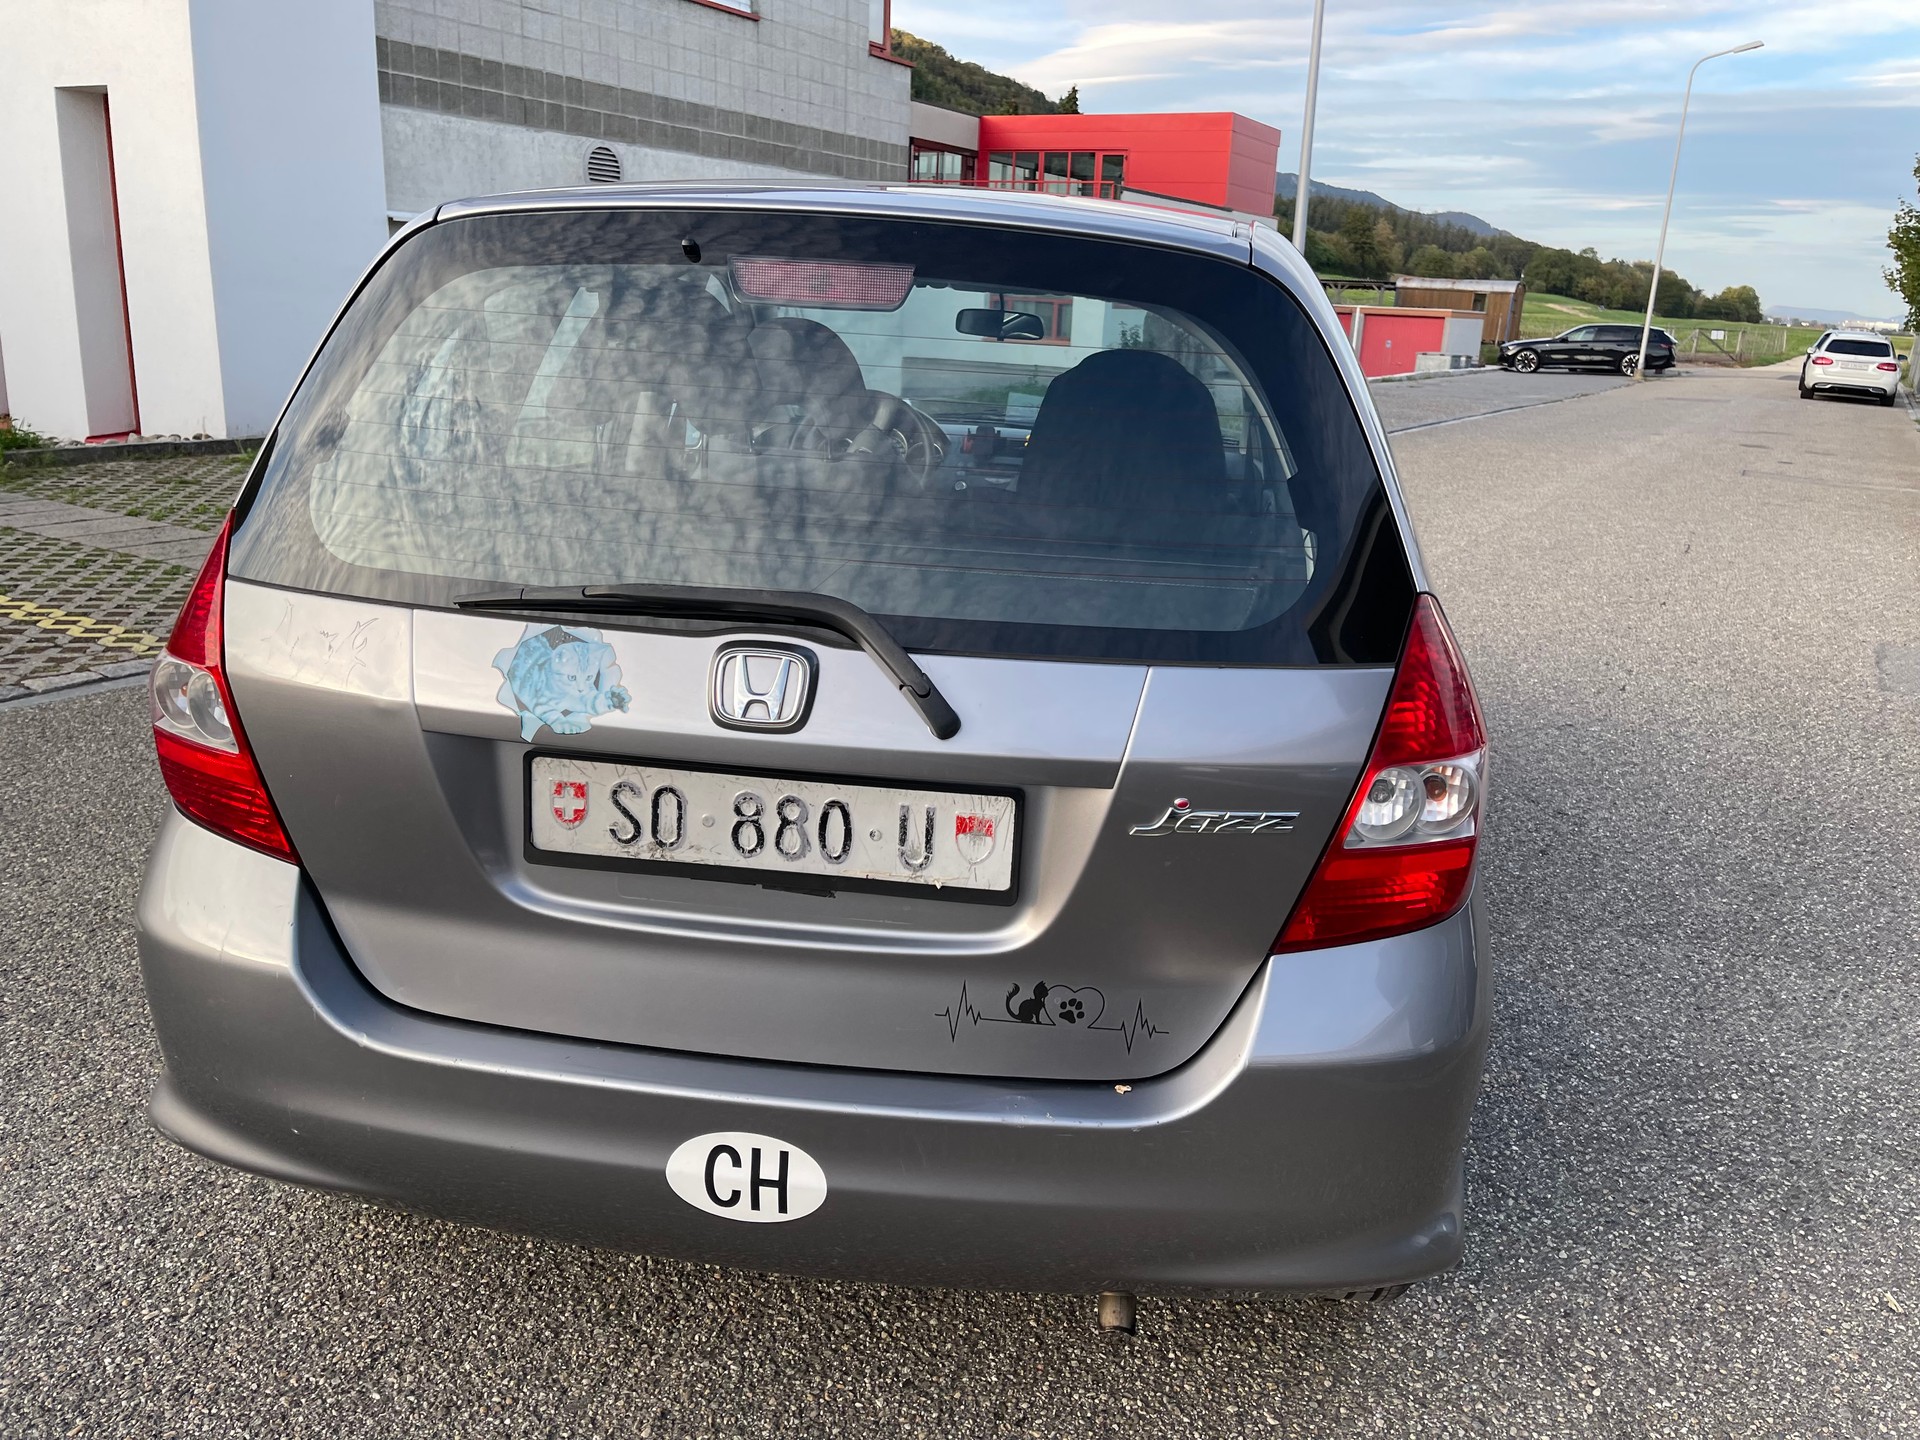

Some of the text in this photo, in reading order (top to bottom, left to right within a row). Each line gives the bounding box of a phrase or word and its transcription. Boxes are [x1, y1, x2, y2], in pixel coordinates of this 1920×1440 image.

[608, 780, 937, 873] SO 880 U
[704, 1144, 790, 1215] CH
